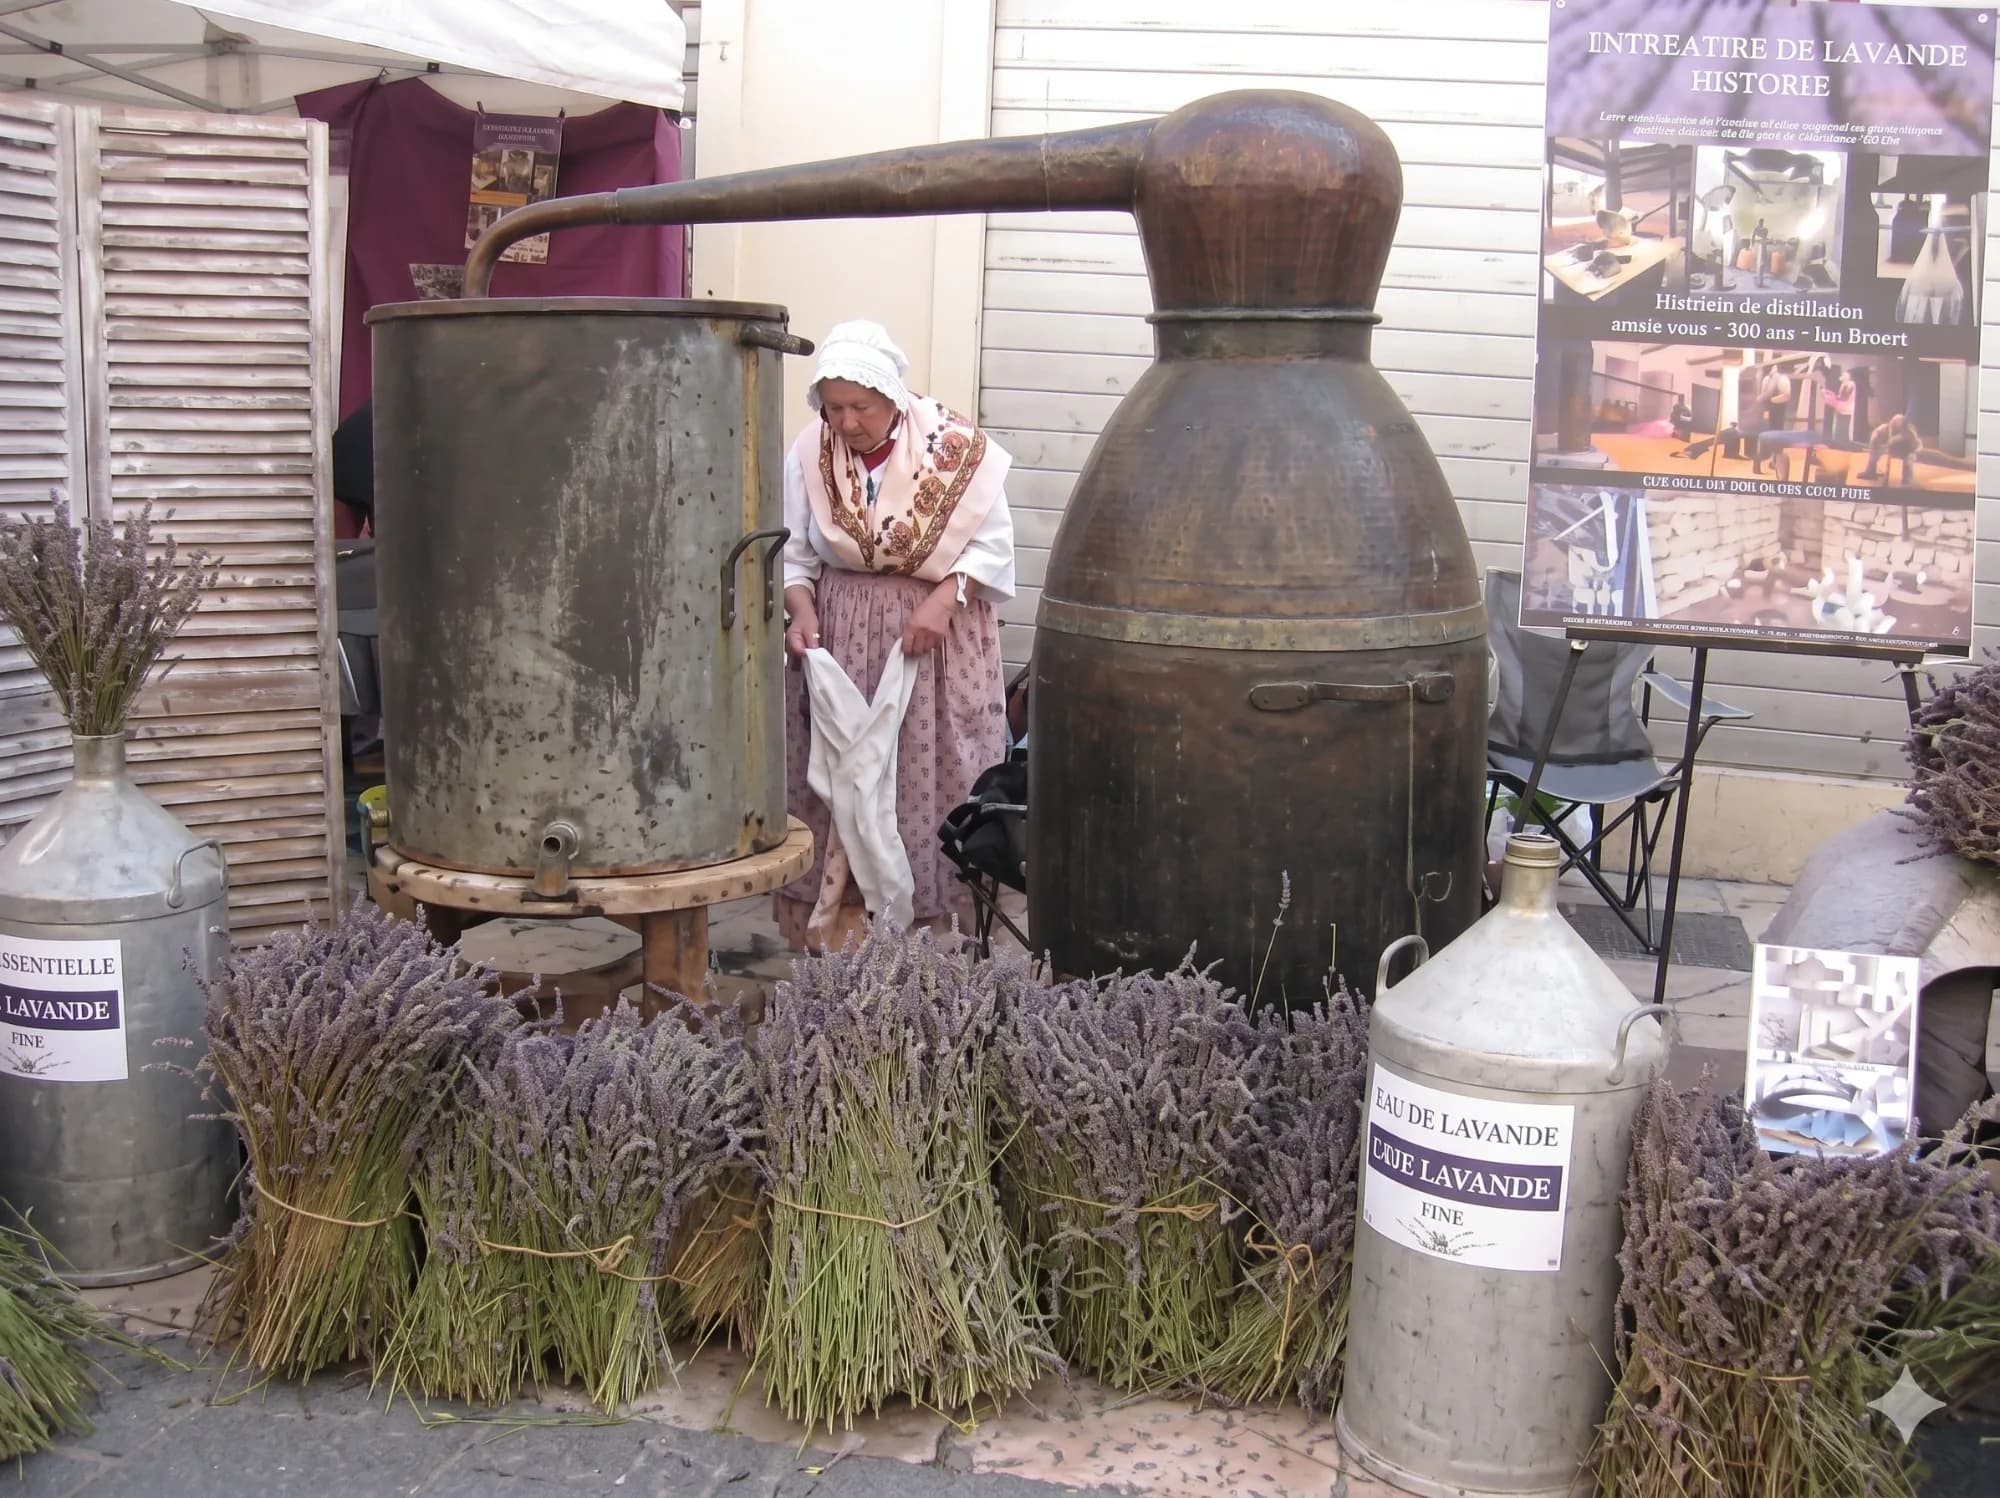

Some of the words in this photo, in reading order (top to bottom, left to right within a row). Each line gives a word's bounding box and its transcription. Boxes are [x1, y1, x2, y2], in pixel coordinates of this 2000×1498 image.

[1776, 38, 1815, 62] DE
[1823, 40, 1968, 67] LAVANDE
[1690, 69, 1830, 97] HISTORIE
[1655, 293, 1734, 313] Histriein
[1739, 297, 1761, 314] de
[1766, 298, 1864, 320] distillation
[1611, 317, 1662, 334] amsie
[1667, 322, 1708, 336] vous
[1727, 321, 1761, 339] 300
[1765, 326, 1795, 341] ans
[1848, 326, 1908, 347] Broert
[0, 952, 115, 976] SSENTIELLE
[5, 995, 110, 1020] LAVANDE
[11, 1031, 44, 1048] FINE
[1375, 1086, 1405, 1119] EAU
[1408, 1103, 1435, 1130] DE
[1440, 1113, 1559, 1147] LAVANDE
[1420, 1158, 1551, 1200] LAVANDE
[1421, 1201, 1464, 1226] FINE
